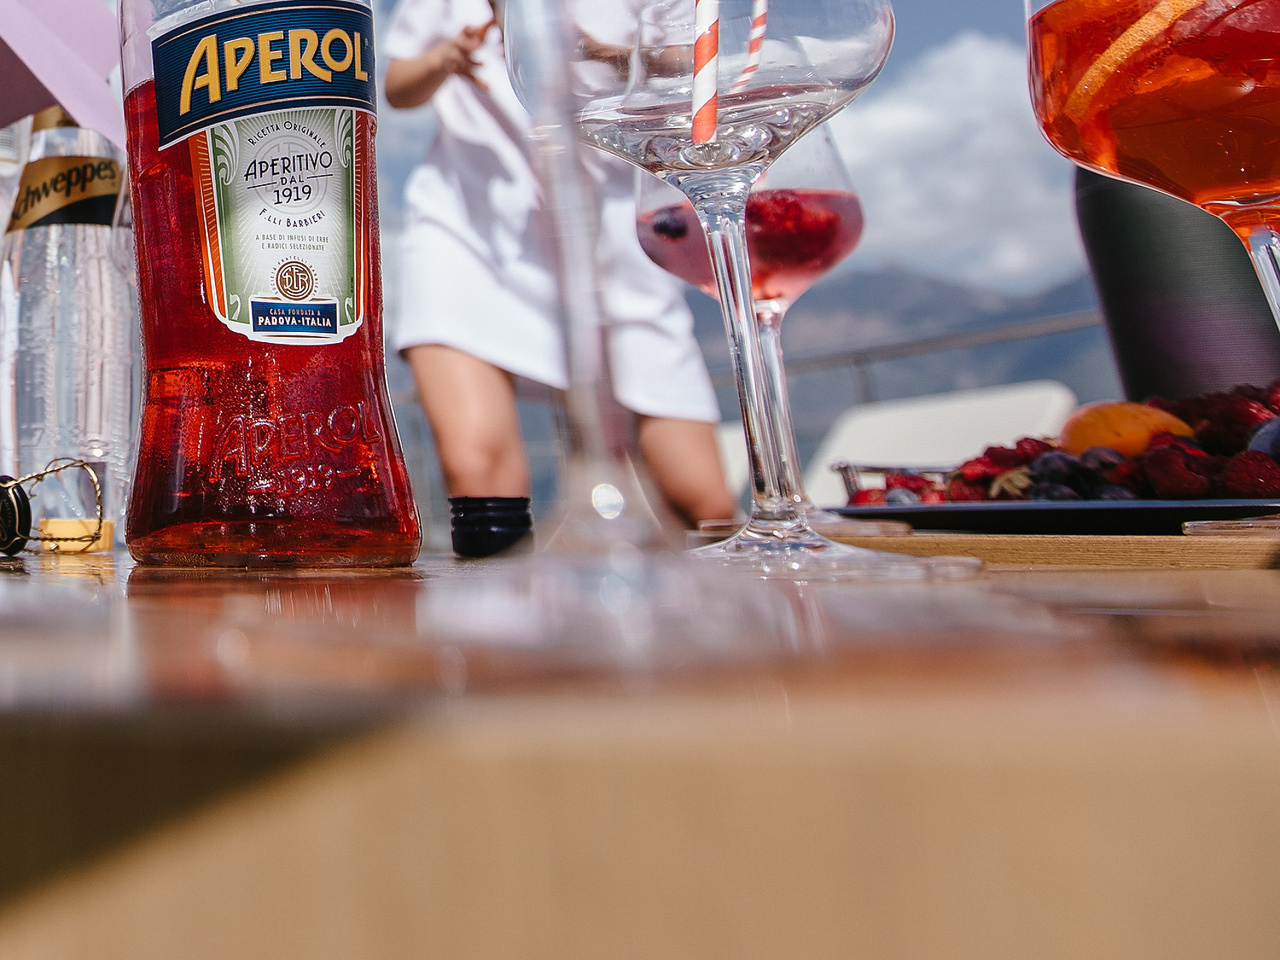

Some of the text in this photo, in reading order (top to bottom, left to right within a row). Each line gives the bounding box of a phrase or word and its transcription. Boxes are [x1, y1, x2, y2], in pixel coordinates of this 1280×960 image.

[179, 28, 369, 116] APEROL
[248, 120, 326, 148] RICETTA ORIGINALE
[243, 150, 333, 182] APERITIVO
[279, 174, 305, 186] DAL
[273, 184, 312, 205] 1919
[259, 208, 326, 228] F.LLI BARBIERI
[287, 234, 307, 242] INFUSI
[316, 236, 329, 244] ERBE
[289, 243, 325, 252] SELEZIONATE
[269, 308, 286, 316] CASA
[288, 308, 315, 316] FONDATA
[208, 400, 382, 483] APEROL
